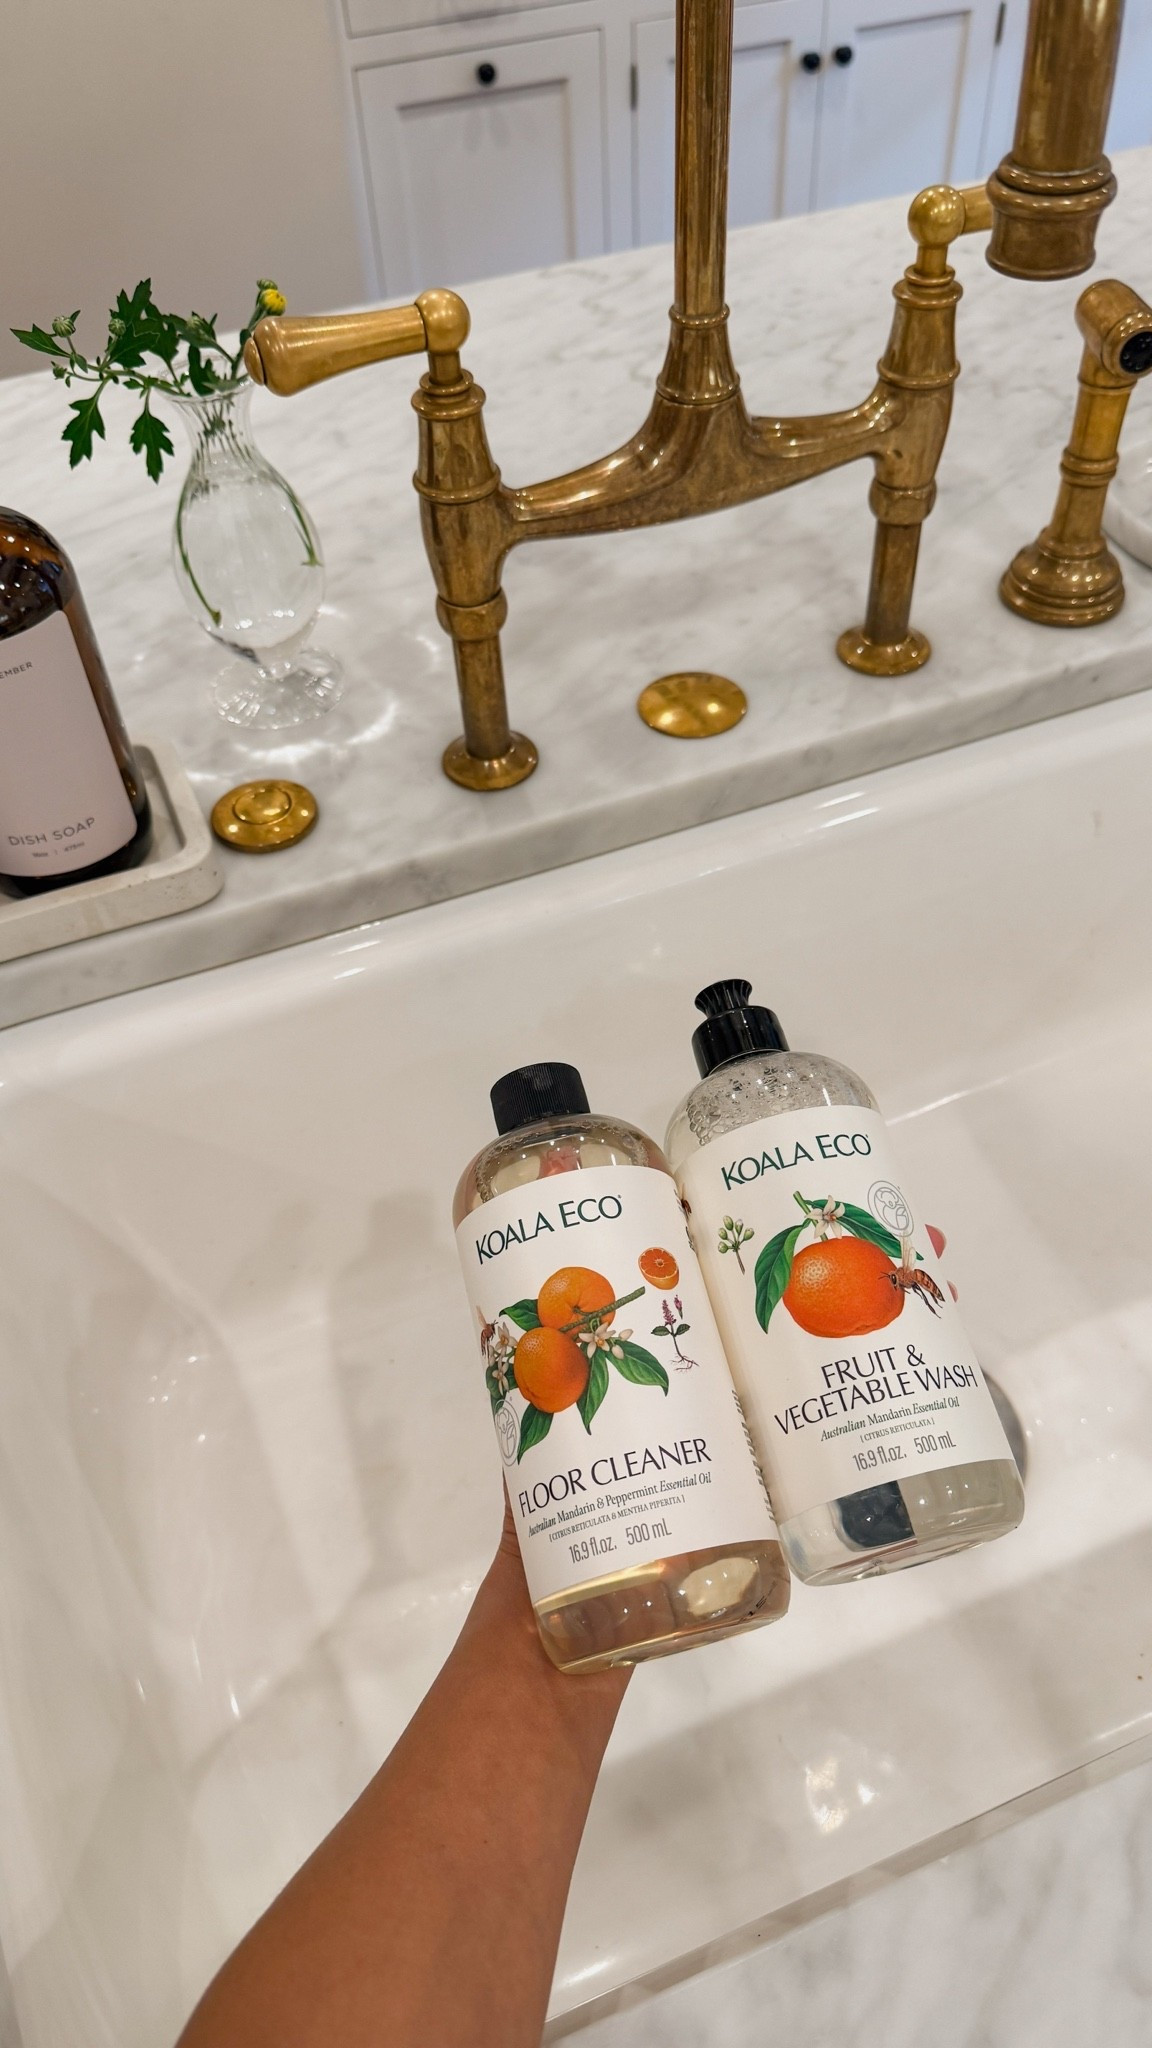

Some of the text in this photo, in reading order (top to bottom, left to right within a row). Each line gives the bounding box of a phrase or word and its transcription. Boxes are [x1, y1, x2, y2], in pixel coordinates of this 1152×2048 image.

[8, 817, 95, 846] DISH SOAP
[720, 1133, 872, 1190] KOALA ECO
[475, 1195, 622, 1265] KOALA ECO
[821, 1344, 926, 1389] FRUIT &
[774, 1364, 978, 1435] VEGETABLE WASH
[820, 1396, 960, 1441] Australian Mandarin Essential Oil
[852, 1449, 878, 1471] 16.9
[913, 1434, 938, 1455] 500
[938, 1430, 957, 1450] mL
[864, 1428, 890, 1441] CITRUS
[889, 1418, 932, 1433] RETICULATA
[518, 1438, 712, 1518] FLOOR CLEANER
[528, 1471, 712, 1538] Australian Mandarin & Peppermint Essential Oil
[552, 1526, 572, 1540] CITRUS
[571, 1515, 611, 1534] RETICULATA
[617, 1504, 649, 1518] MENTHA
[649, 1497, 681, 1510] PIPERITA
[568, 1541, 590, 1564] 16.9
[625, 1523, 651, 1546] 500
[651, 1518, 672, 1538] mL
